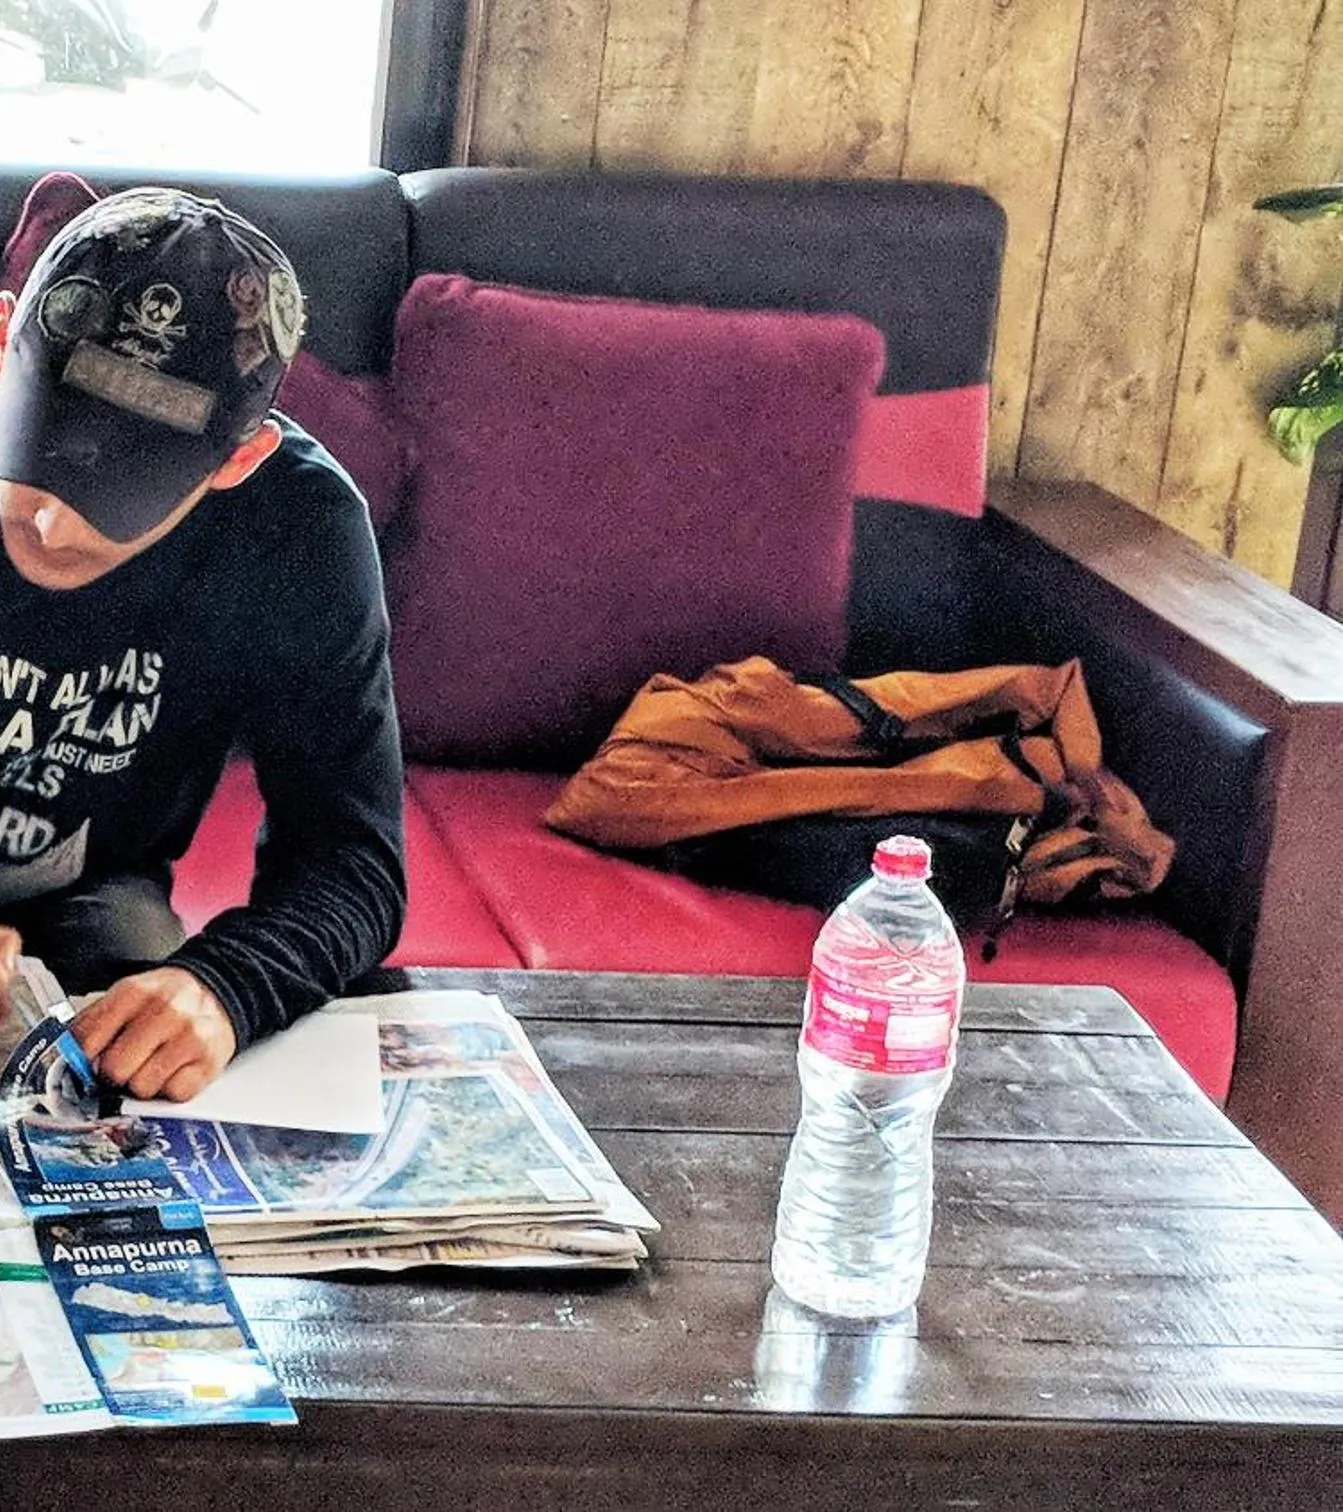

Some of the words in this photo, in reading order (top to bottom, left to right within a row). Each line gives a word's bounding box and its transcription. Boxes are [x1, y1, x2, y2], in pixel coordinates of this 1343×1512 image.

[18, 1038, 47, 1073] Camp
[53, 1238, 202, 1262] Annapurna
[74, 1262, 126, 1277] Base
[130, 1258, 191, 1273] Camp
